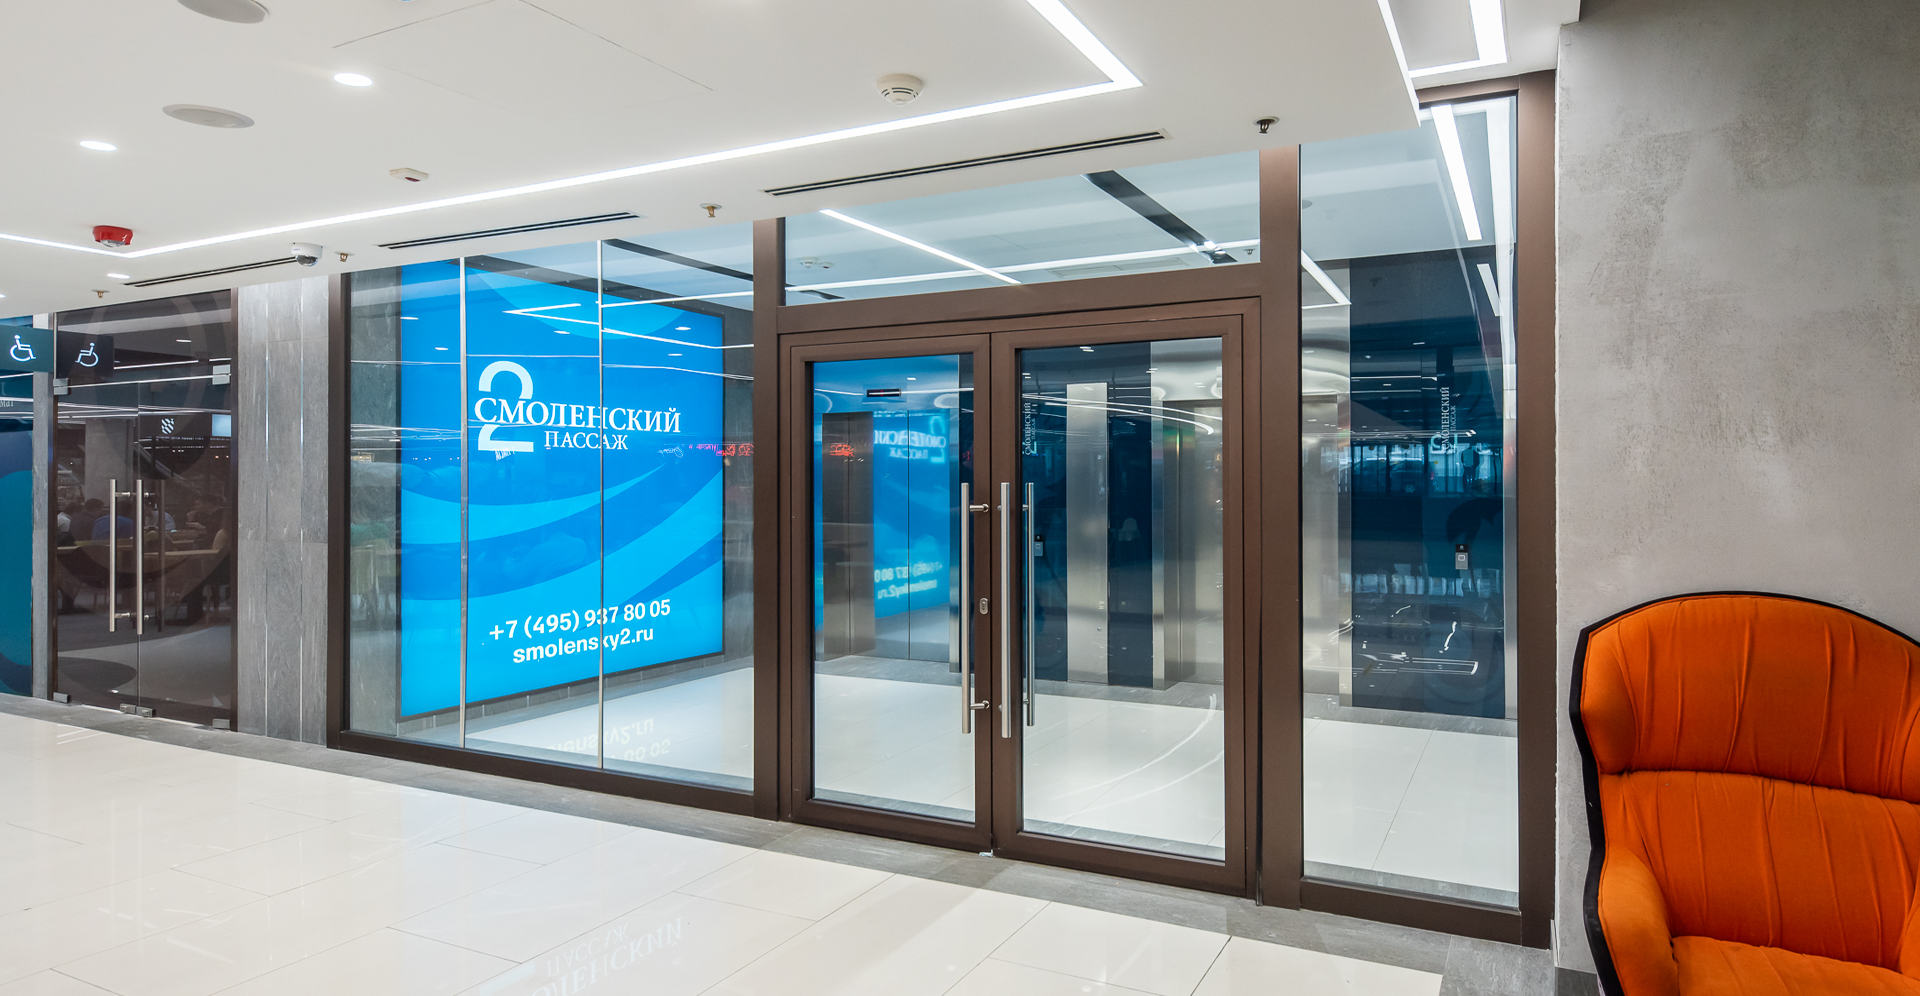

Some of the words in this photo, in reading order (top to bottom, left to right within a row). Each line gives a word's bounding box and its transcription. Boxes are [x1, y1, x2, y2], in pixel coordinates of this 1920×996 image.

[474, 397, 681, 433] СМОЛЕНСКИЙ
[478, 360, 534, 453] 2
[544, 430, 628, 450] ПАССАЖ
[489, 619, 518, 640] +7
[524, 609, 580, 639] (495)
[584, 606, 619, 627] 937
[623, 602, 646, 622] 80
[649, 599, 671, 618] 05
[513, 628, 654, 664] smolensky2.ru
